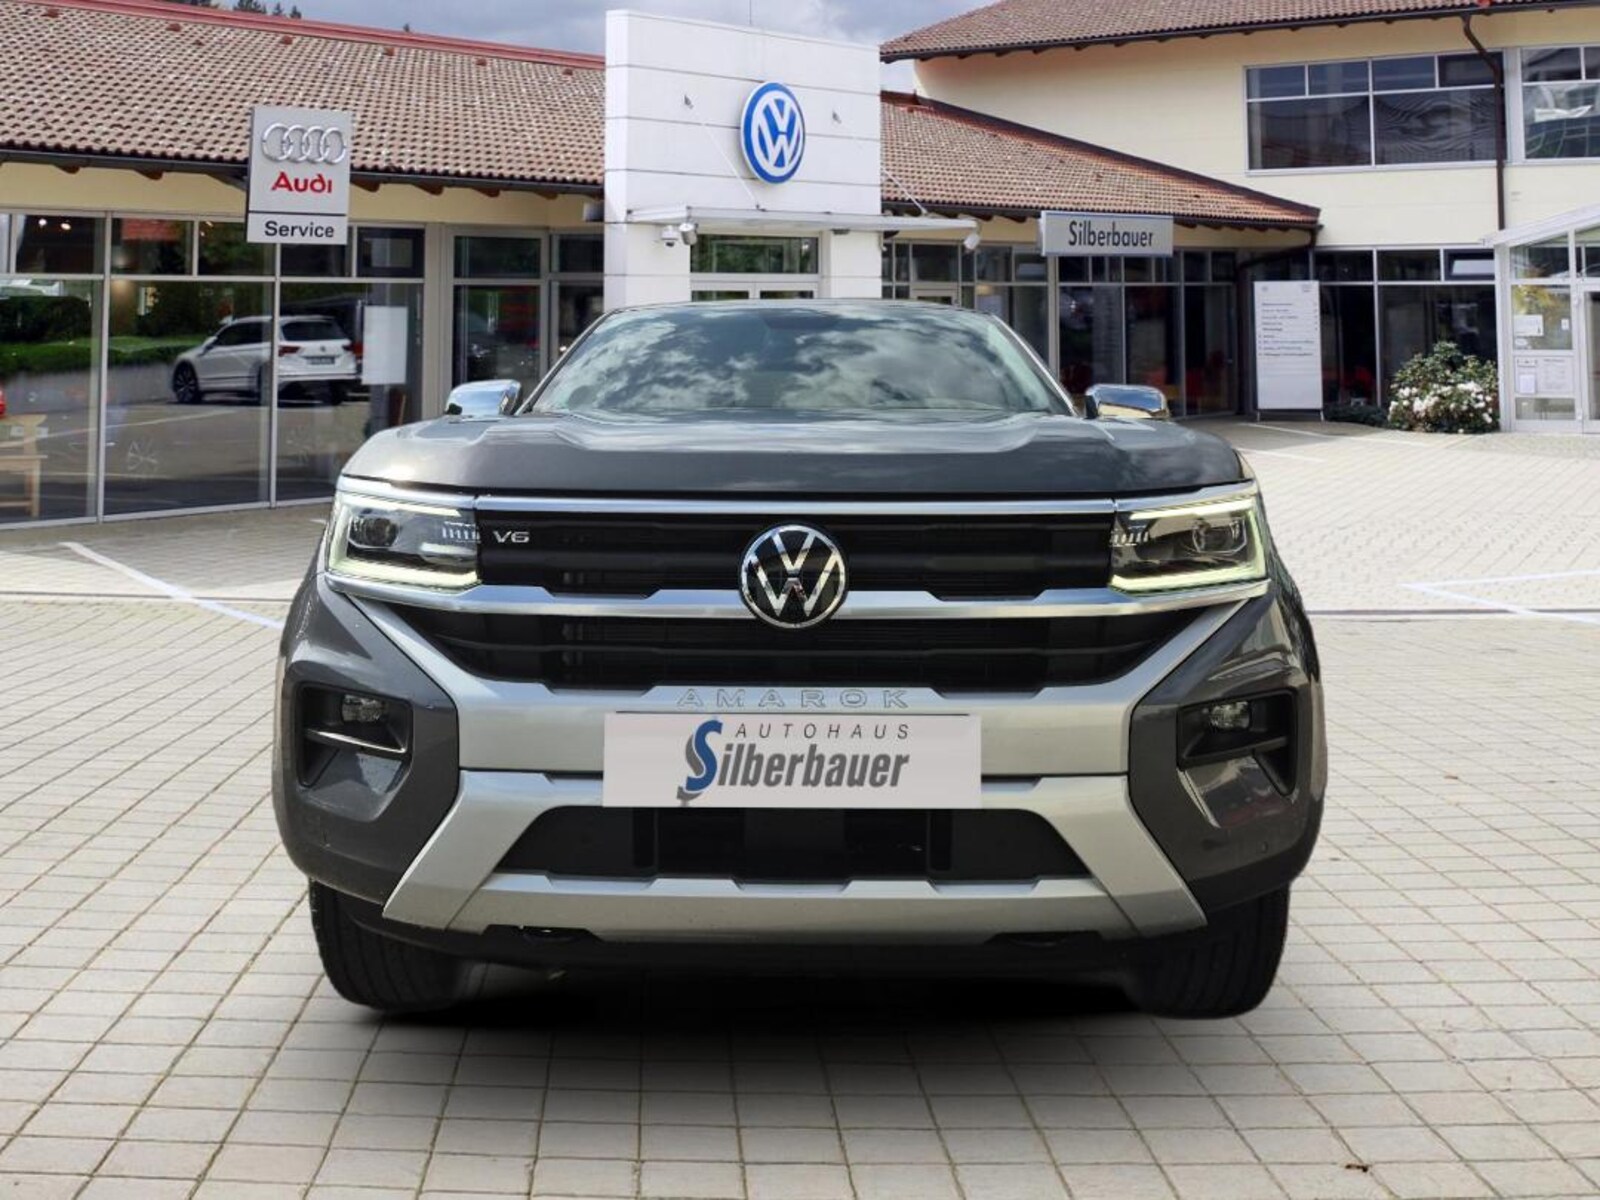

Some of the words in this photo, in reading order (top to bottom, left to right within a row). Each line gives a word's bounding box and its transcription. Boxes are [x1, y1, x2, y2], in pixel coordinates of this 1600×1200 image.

[271, 171, 333, 194] Audi
[264, 220, 335, 238] Service
[1068, 220, 1154, 247] Silberbauer
[493, 531, 530, 543] V6
[676, 688, 909, 709] AMAROK
[735, 723, 910, 740] AUTOHAUS
[677, 718, 910, 800] Silberbauer
